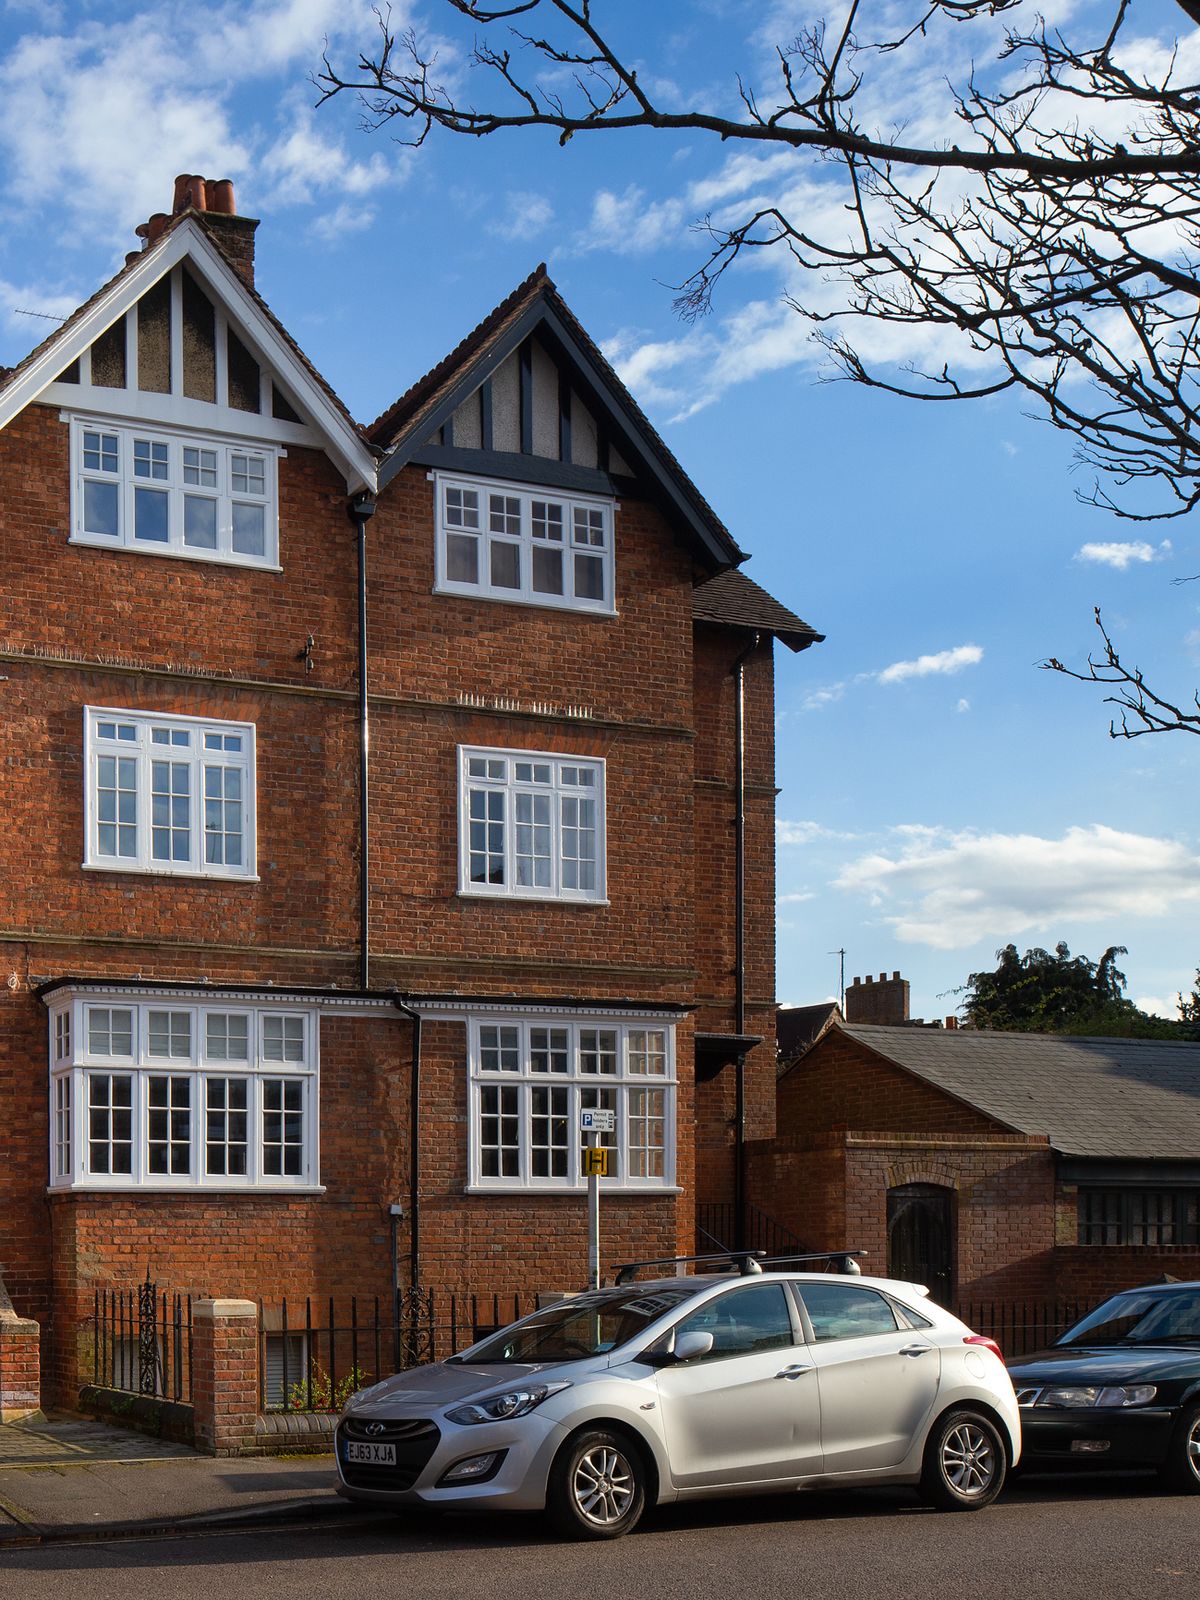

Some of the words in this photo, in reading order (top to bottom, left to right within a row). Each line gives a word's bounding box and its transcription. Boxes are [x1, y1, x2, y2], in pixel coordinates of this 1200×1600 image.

[584, 1114, 592, 1125] P
[589, 1150, 604, 1172] H
[349, 1443, 371, 1460] EJ63
[373, 1445, 394, 1462] XJA
